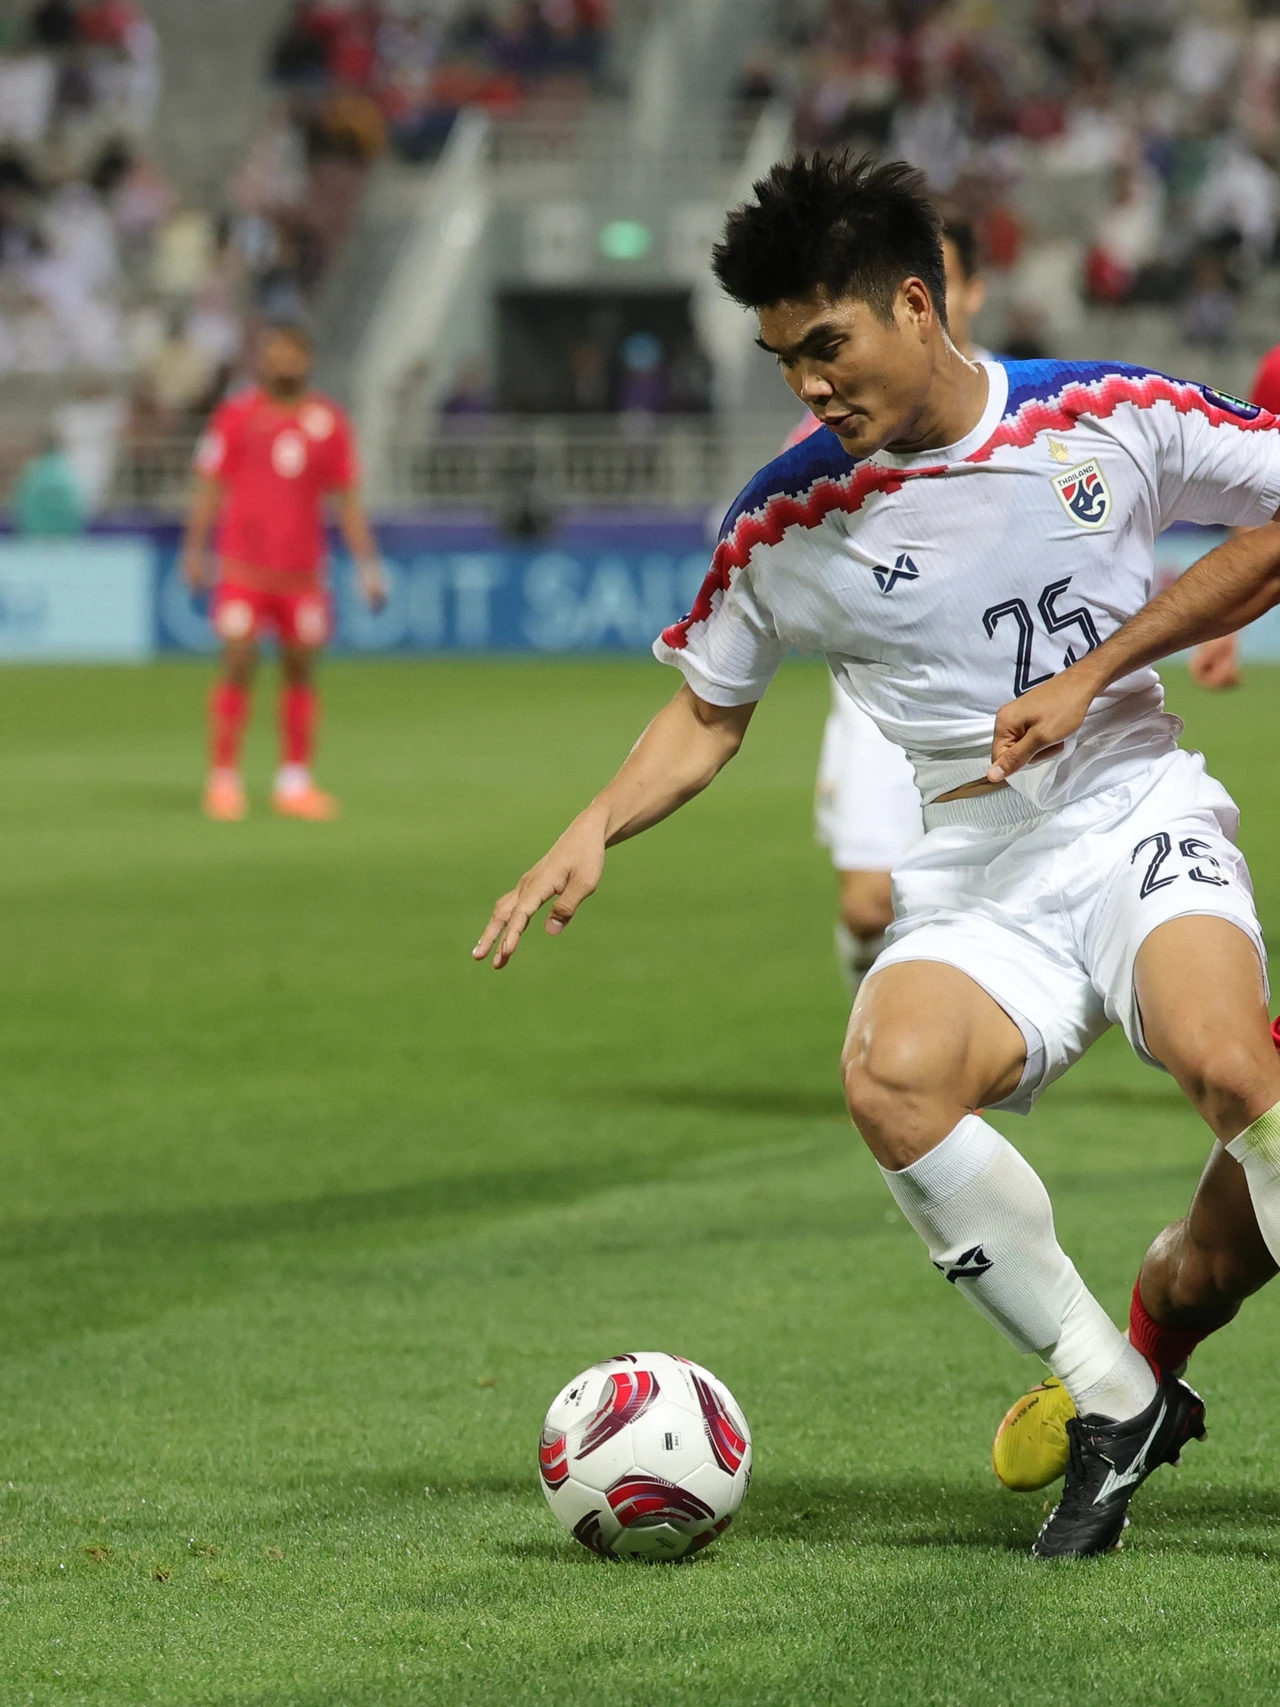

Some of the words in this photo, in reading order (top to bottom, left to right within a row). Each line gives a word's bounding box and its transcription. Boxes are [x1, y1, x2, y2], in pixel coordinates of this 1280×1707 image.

[1057, 465, 1094, 487] THAILAND
[982, 575, 1103, 699] 25
[1130, 831, 1230, 901] 25
[574, 1379, 590, 1408] KELME
